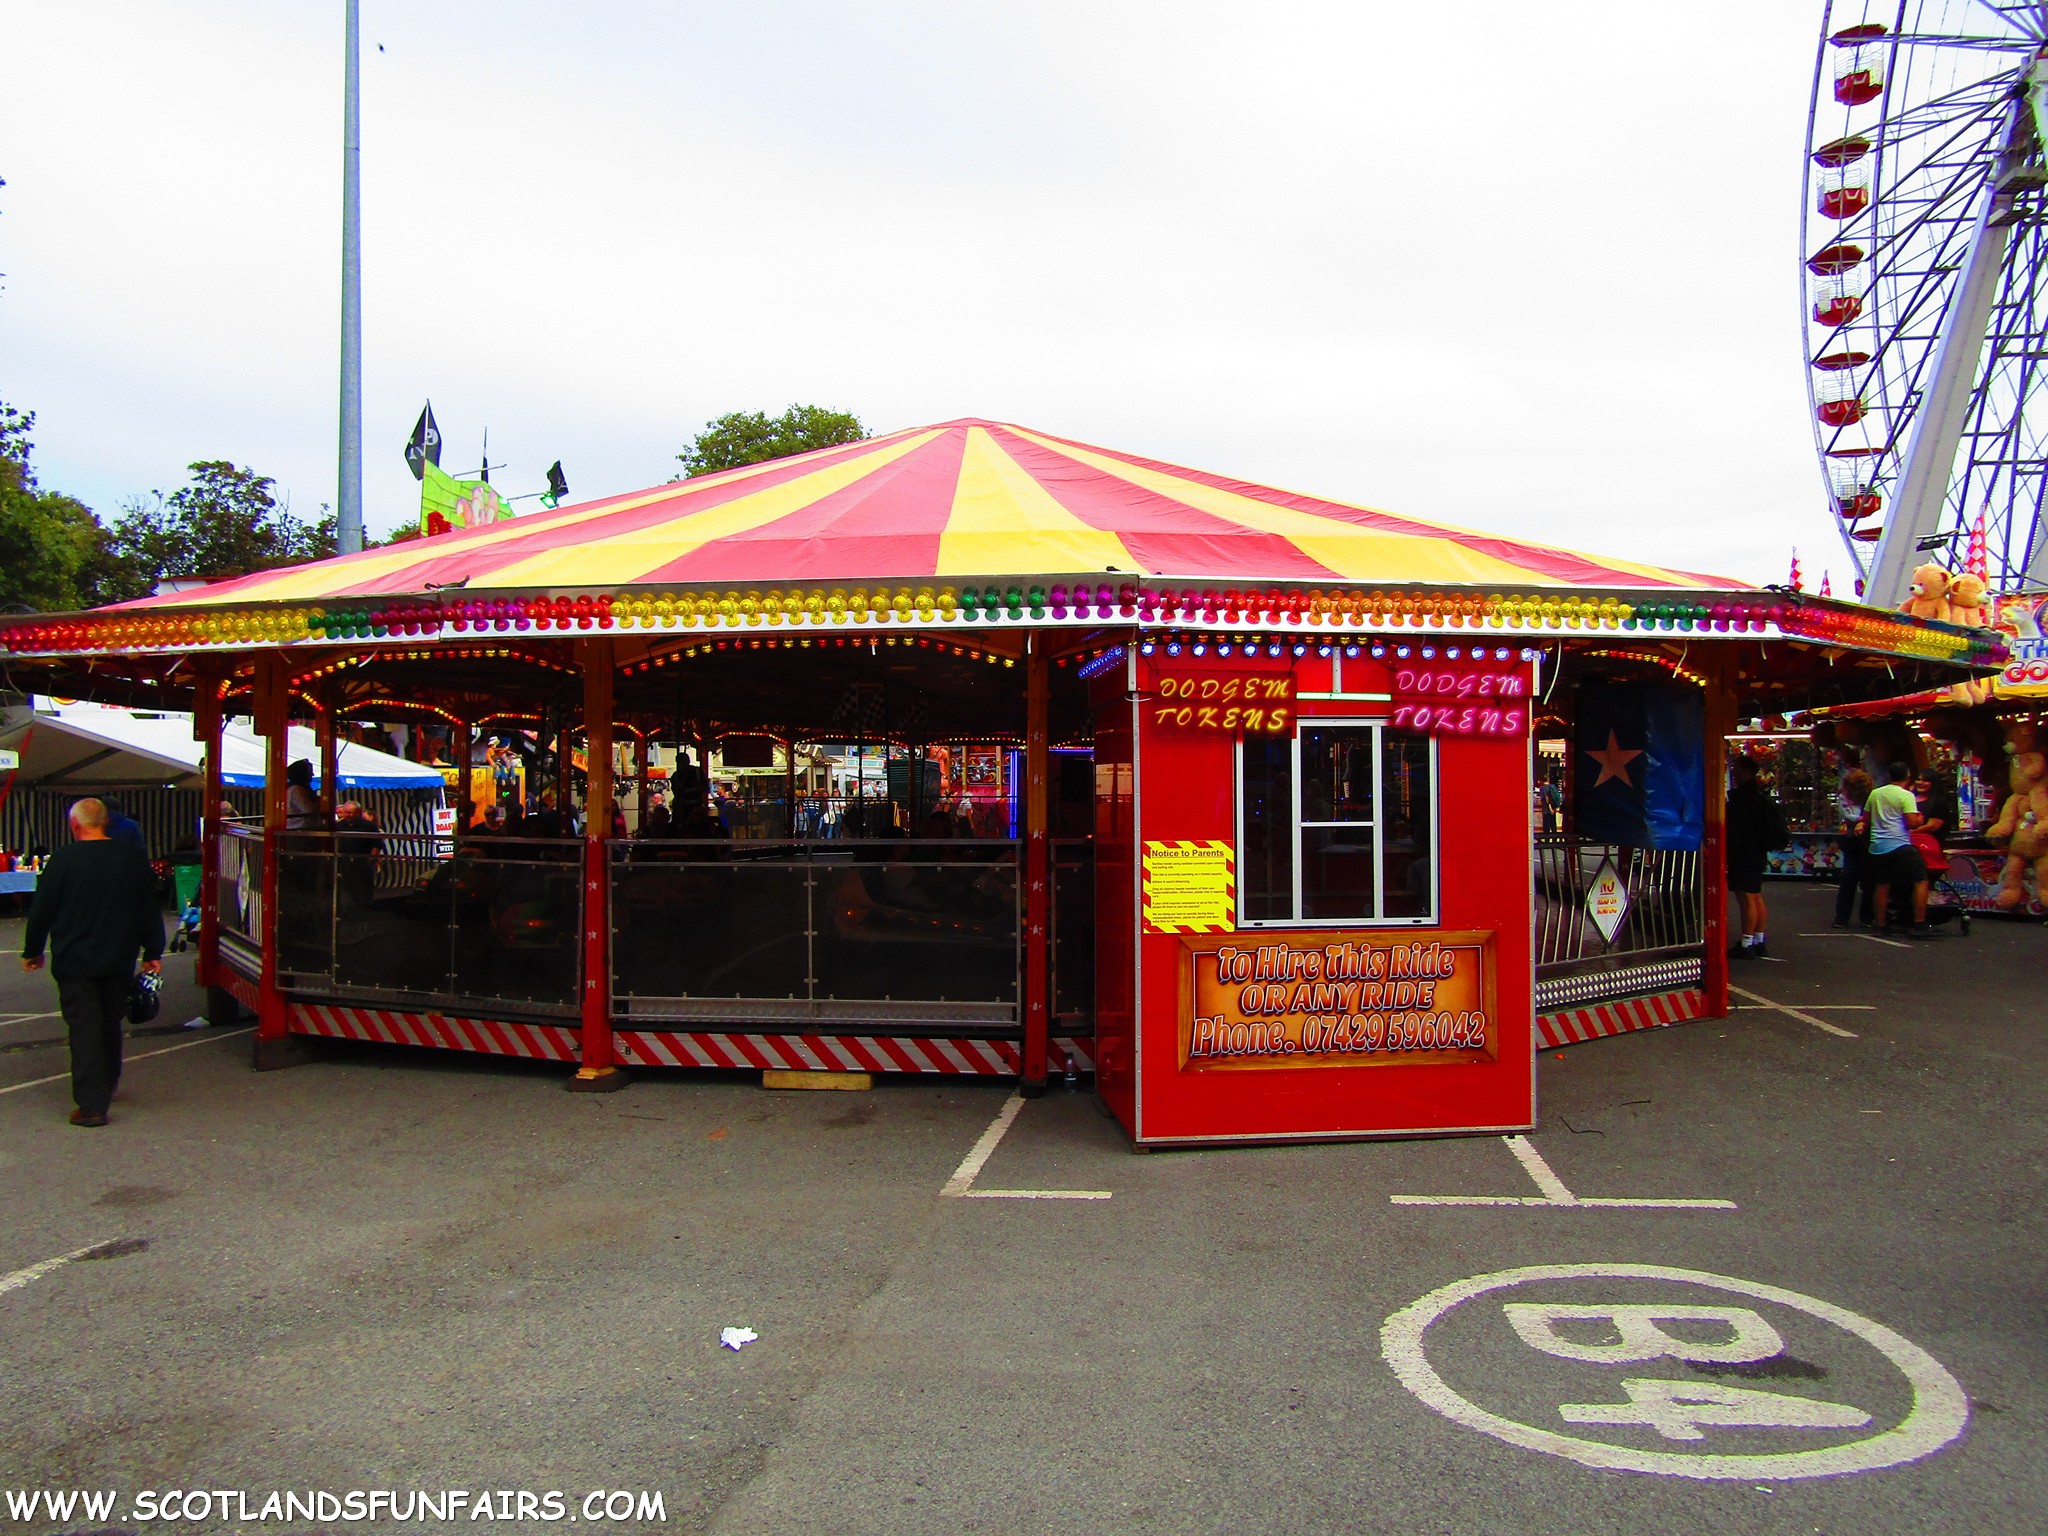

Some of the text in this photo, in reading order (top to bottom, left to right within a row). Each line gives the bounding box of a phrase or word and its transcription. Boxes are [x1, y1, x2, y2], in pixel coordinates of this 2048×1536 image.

[1158, 676, 1290, 702] DODGEM
[1396, 671, 1522, 698] DODGEM
[1155, 706, 1289, 732] TOKENS
[1393, 705, 1522, 734] TOKENS
[438, 811, 451, 820] HOT
[1151, 849, 1225, 857] Notice to Parents
[1218, 943, 1455, 982] To Hire This Ride
[1241, 981, 1435, 1014] OR ANY RIDE
[1190, 1011, 1486, 1057] Phone. 07429 596042
